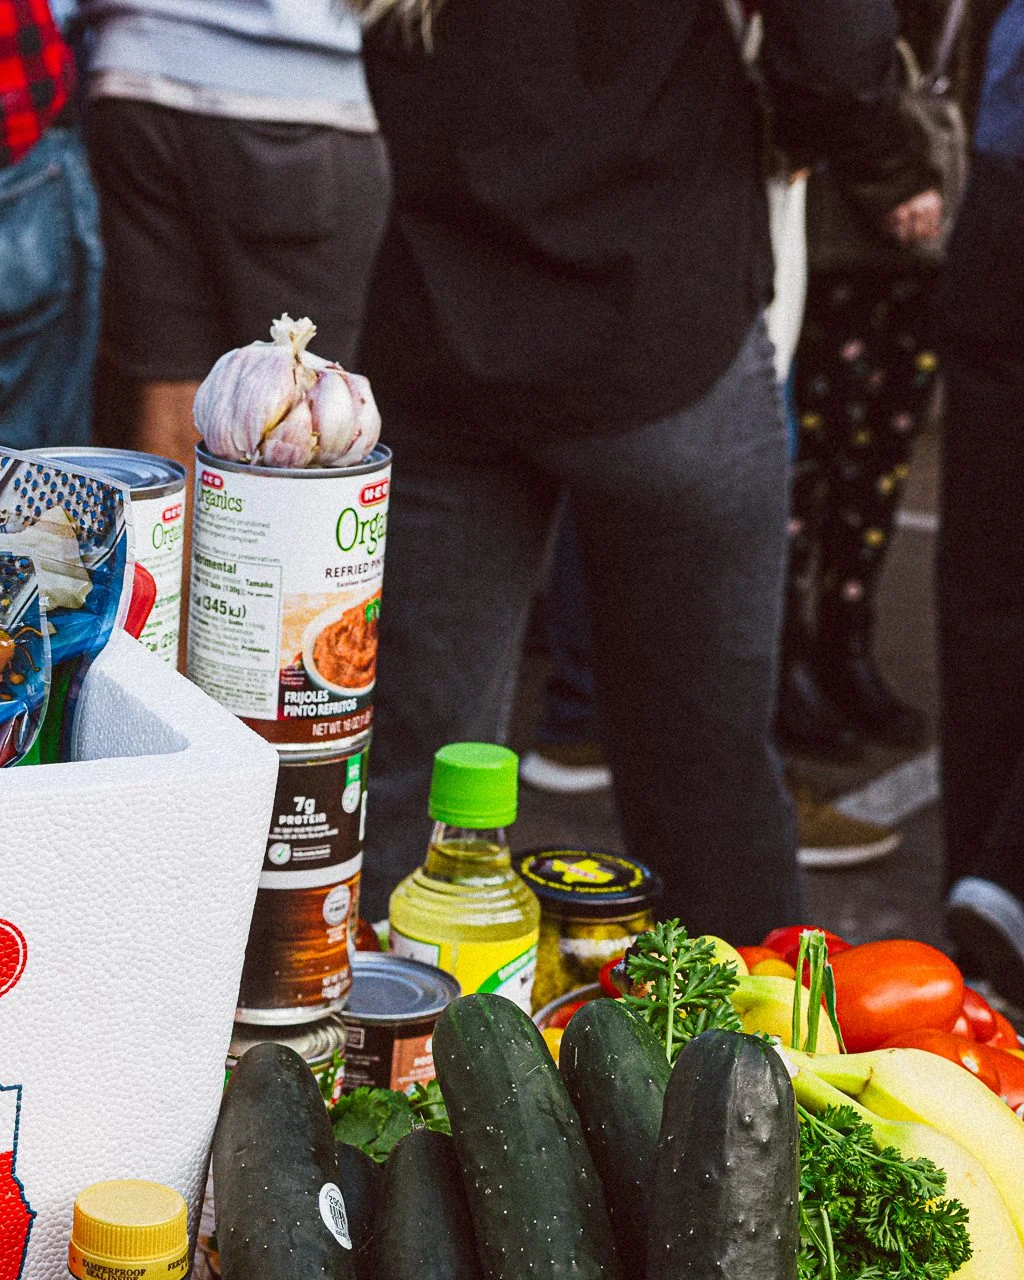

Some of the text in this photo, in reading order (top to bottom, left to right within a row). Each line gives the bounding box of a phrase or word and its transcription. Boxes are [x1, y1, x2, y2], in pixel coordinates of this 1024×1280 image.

[325, 562, 369, 579] REFRIED
[284, 689, 329, 705] FRIJOLES
[283, 698, 358, 717] PINTO REFRITOS
[312, 722, 328, 737] NET
[293, 796, 316, 815] 7g
[279, 812, 327, 825] PROTEIN
[82, 1258, 147, 1277] TAMPERPROOF
[86, 1267, 106, 1280] SEAL
